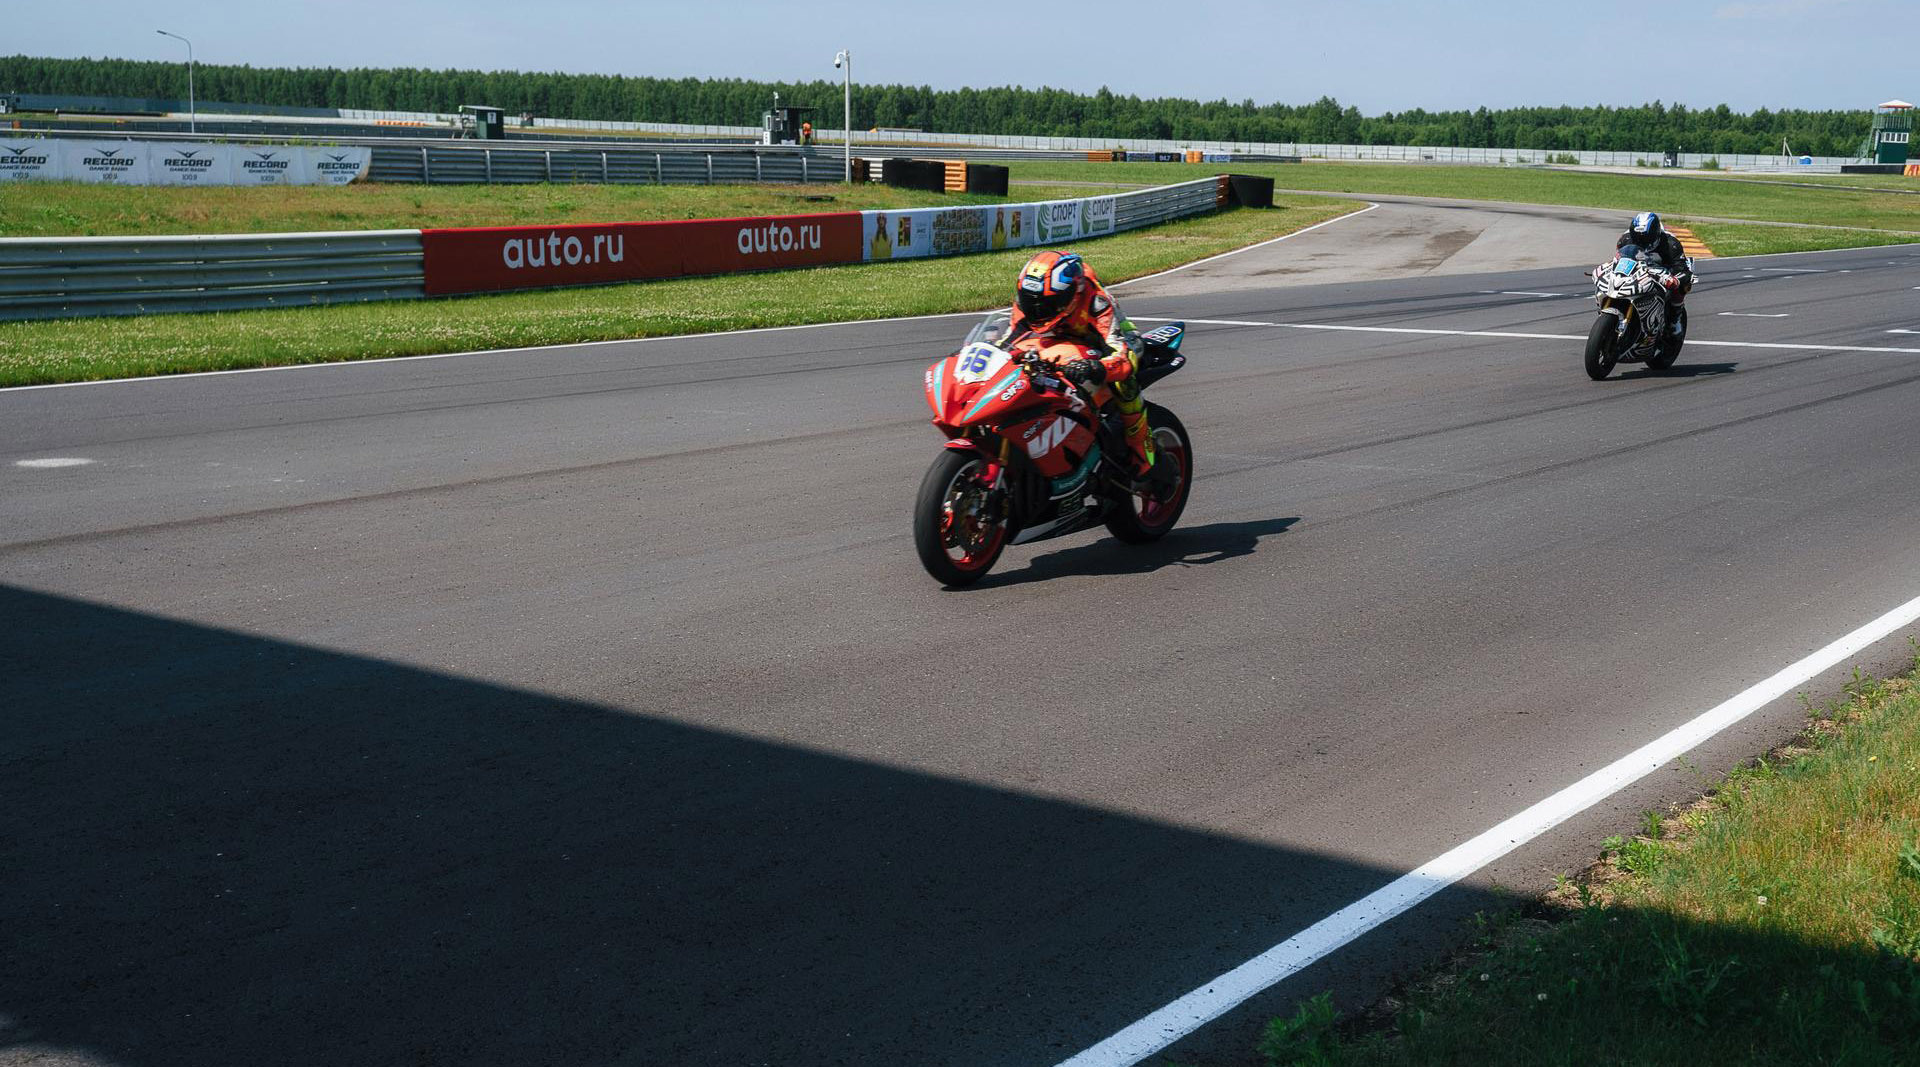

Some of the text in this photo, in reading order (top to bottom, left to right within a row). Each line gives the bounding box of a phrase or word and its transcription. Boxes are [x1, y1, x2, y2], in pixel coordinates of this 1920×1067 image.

[0, 156, 47, 165] ECORD
[83, 157, 134, 166] RECORD
[164, 158, 212, 167] RECORD
[243, 160, 288, 169] RECORD
[317, 162, 360, 170] RECORD
[1092, 199, 1114, 216] СПОРТ
[1052, 203, 1077, 222] СПОРТ
[737, 222, 821, 254] auto.ru
[503, 231, 624, 268] auto.ru
